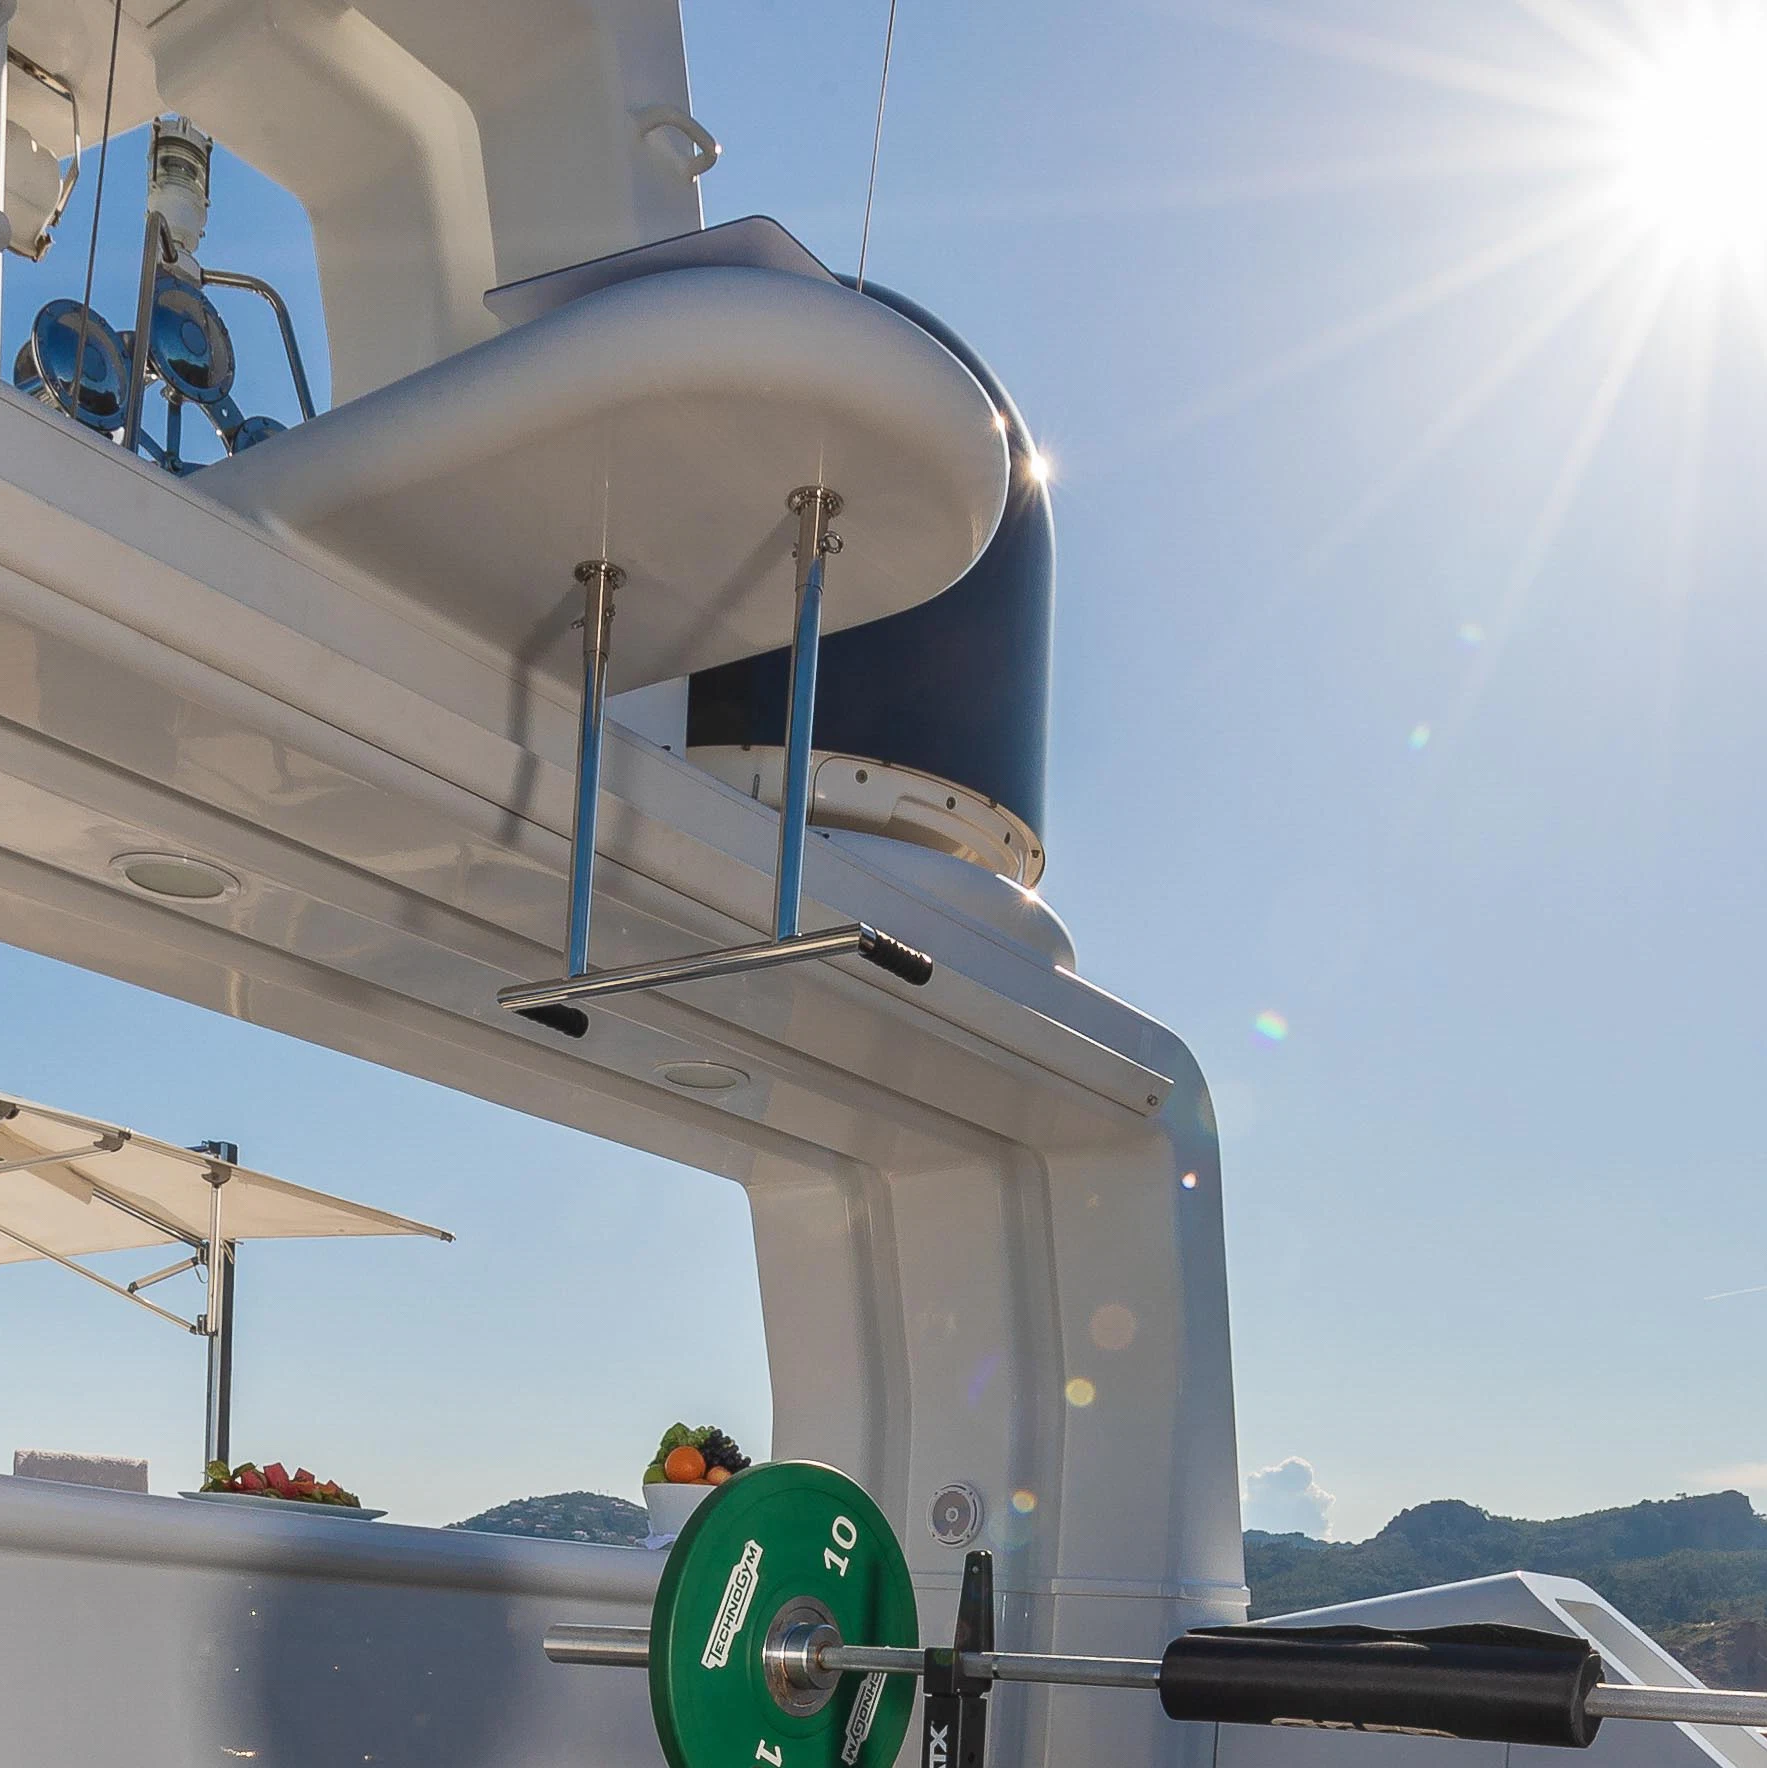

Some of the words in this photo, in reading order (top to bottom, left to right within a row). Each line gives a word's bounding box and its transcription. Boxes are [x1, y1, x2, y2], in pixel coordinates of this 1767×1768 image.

[824, 1515, 857, 1577] 10
[704, 1543, 760, 1666] TECHNOGYM
[844, 1673, 884, 1762] CHNOGYM
